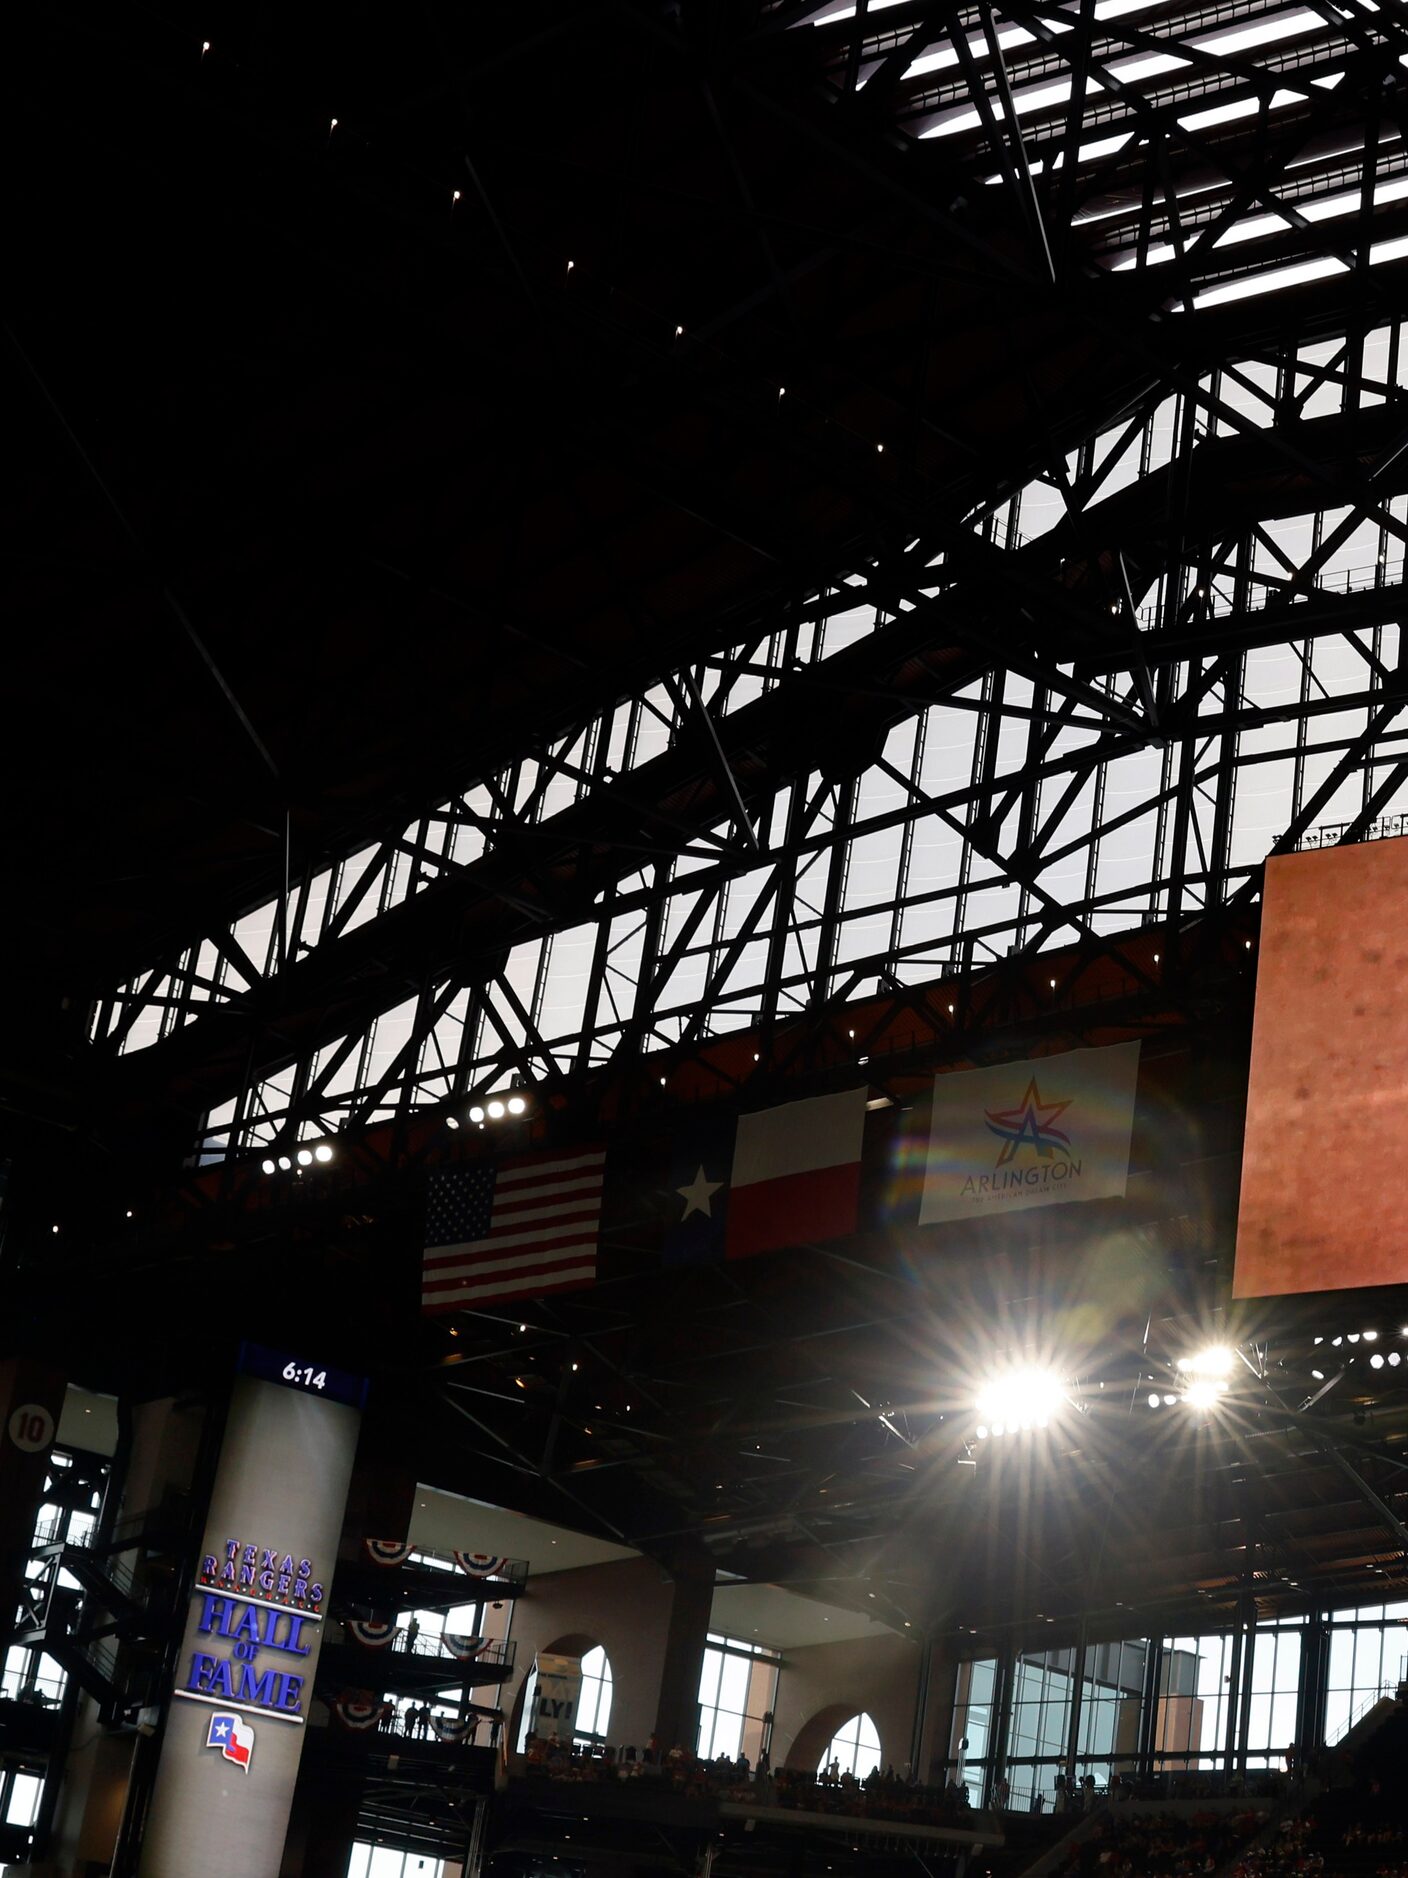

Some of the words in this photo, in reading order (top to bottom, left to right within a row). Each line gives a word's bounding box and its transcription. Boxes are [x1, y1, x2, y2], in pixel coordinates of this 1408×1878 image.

[960, 1160, 1082, 1196] ARLINGTON
[282, 1361, 327, 1390] 6:14
[18, 1412, 45, 1443] 10
[227, 1539, 312, 1578] TEXAS
[202, 1555, 324, 1602] RANGERS
[199, 1593, 312, 1656] HALL
[233, 1641, 260, 1662] OF
[187, 1652, 304, 1713] FAME
